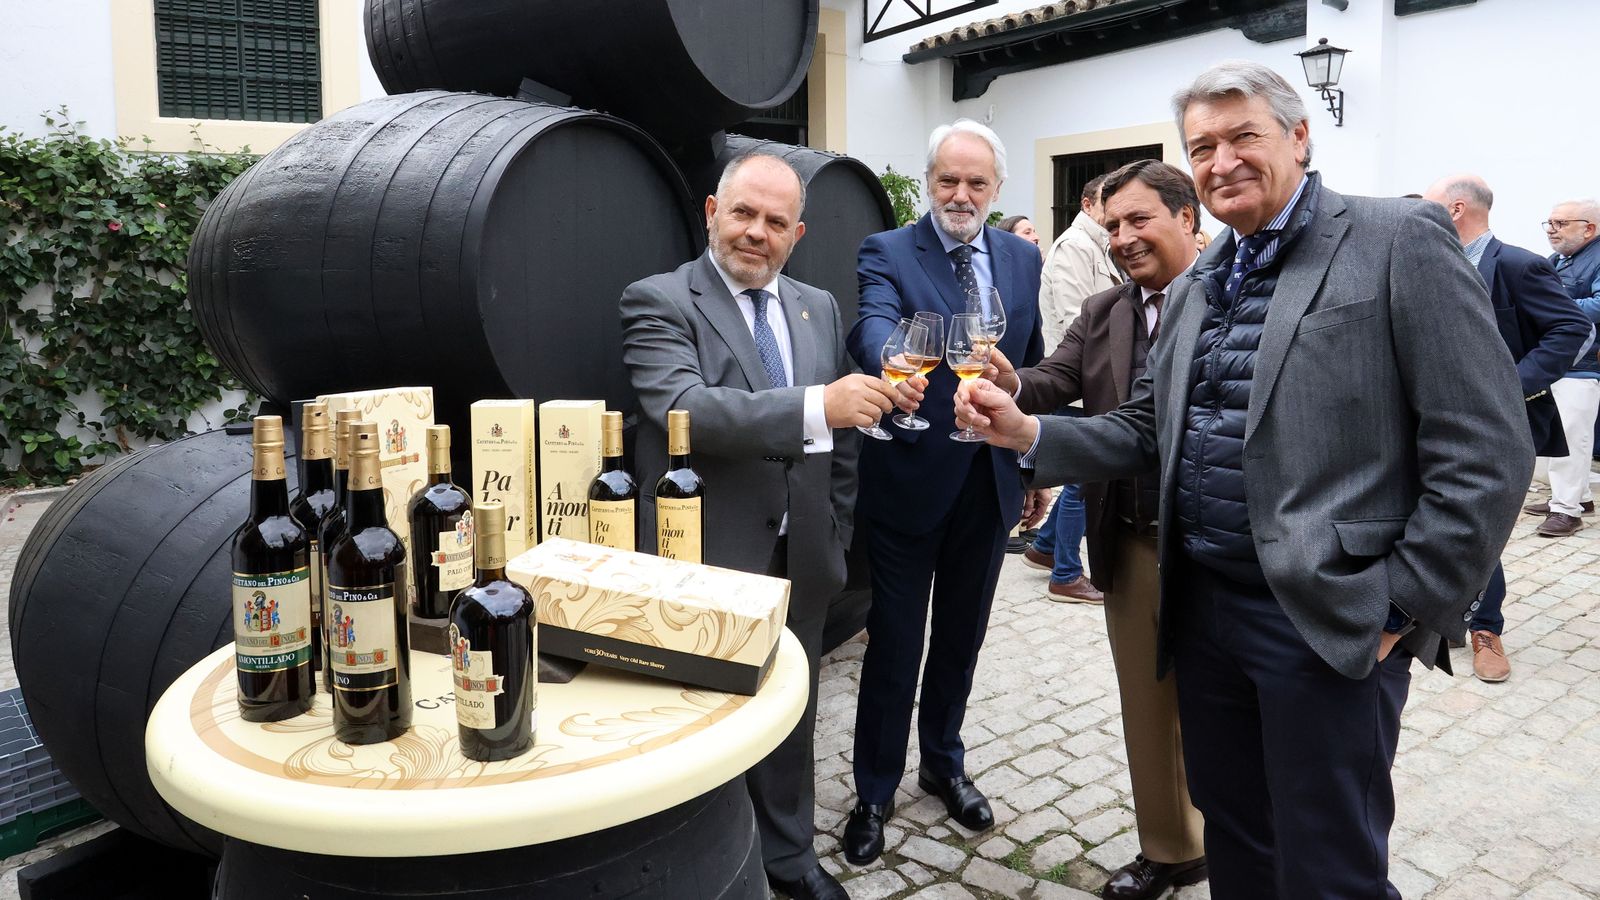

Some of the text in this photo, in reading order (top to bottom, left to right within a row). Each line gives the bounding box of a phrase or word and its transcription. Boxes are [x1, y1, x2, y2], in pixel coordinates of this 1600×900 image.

[480, 470, 512, 491] Pa
[548, 482, 562, 500] A
[547, 501, 587, 517] mon
[547, 518, 562, 535] ti
[595, 520, 610, 532] Pa
[662, 517, 670, 528] A
[595, 533, 605, 544] lo
[662, 528, 684, 538] mon
[662, 538, 669, 549] ti
[662, 549, 676, 559] lla
[267, 577, 287, 586] PINO
[343, 592, 362, 601] PINO
[238, 653, 294, 665] AMONTILLADO
